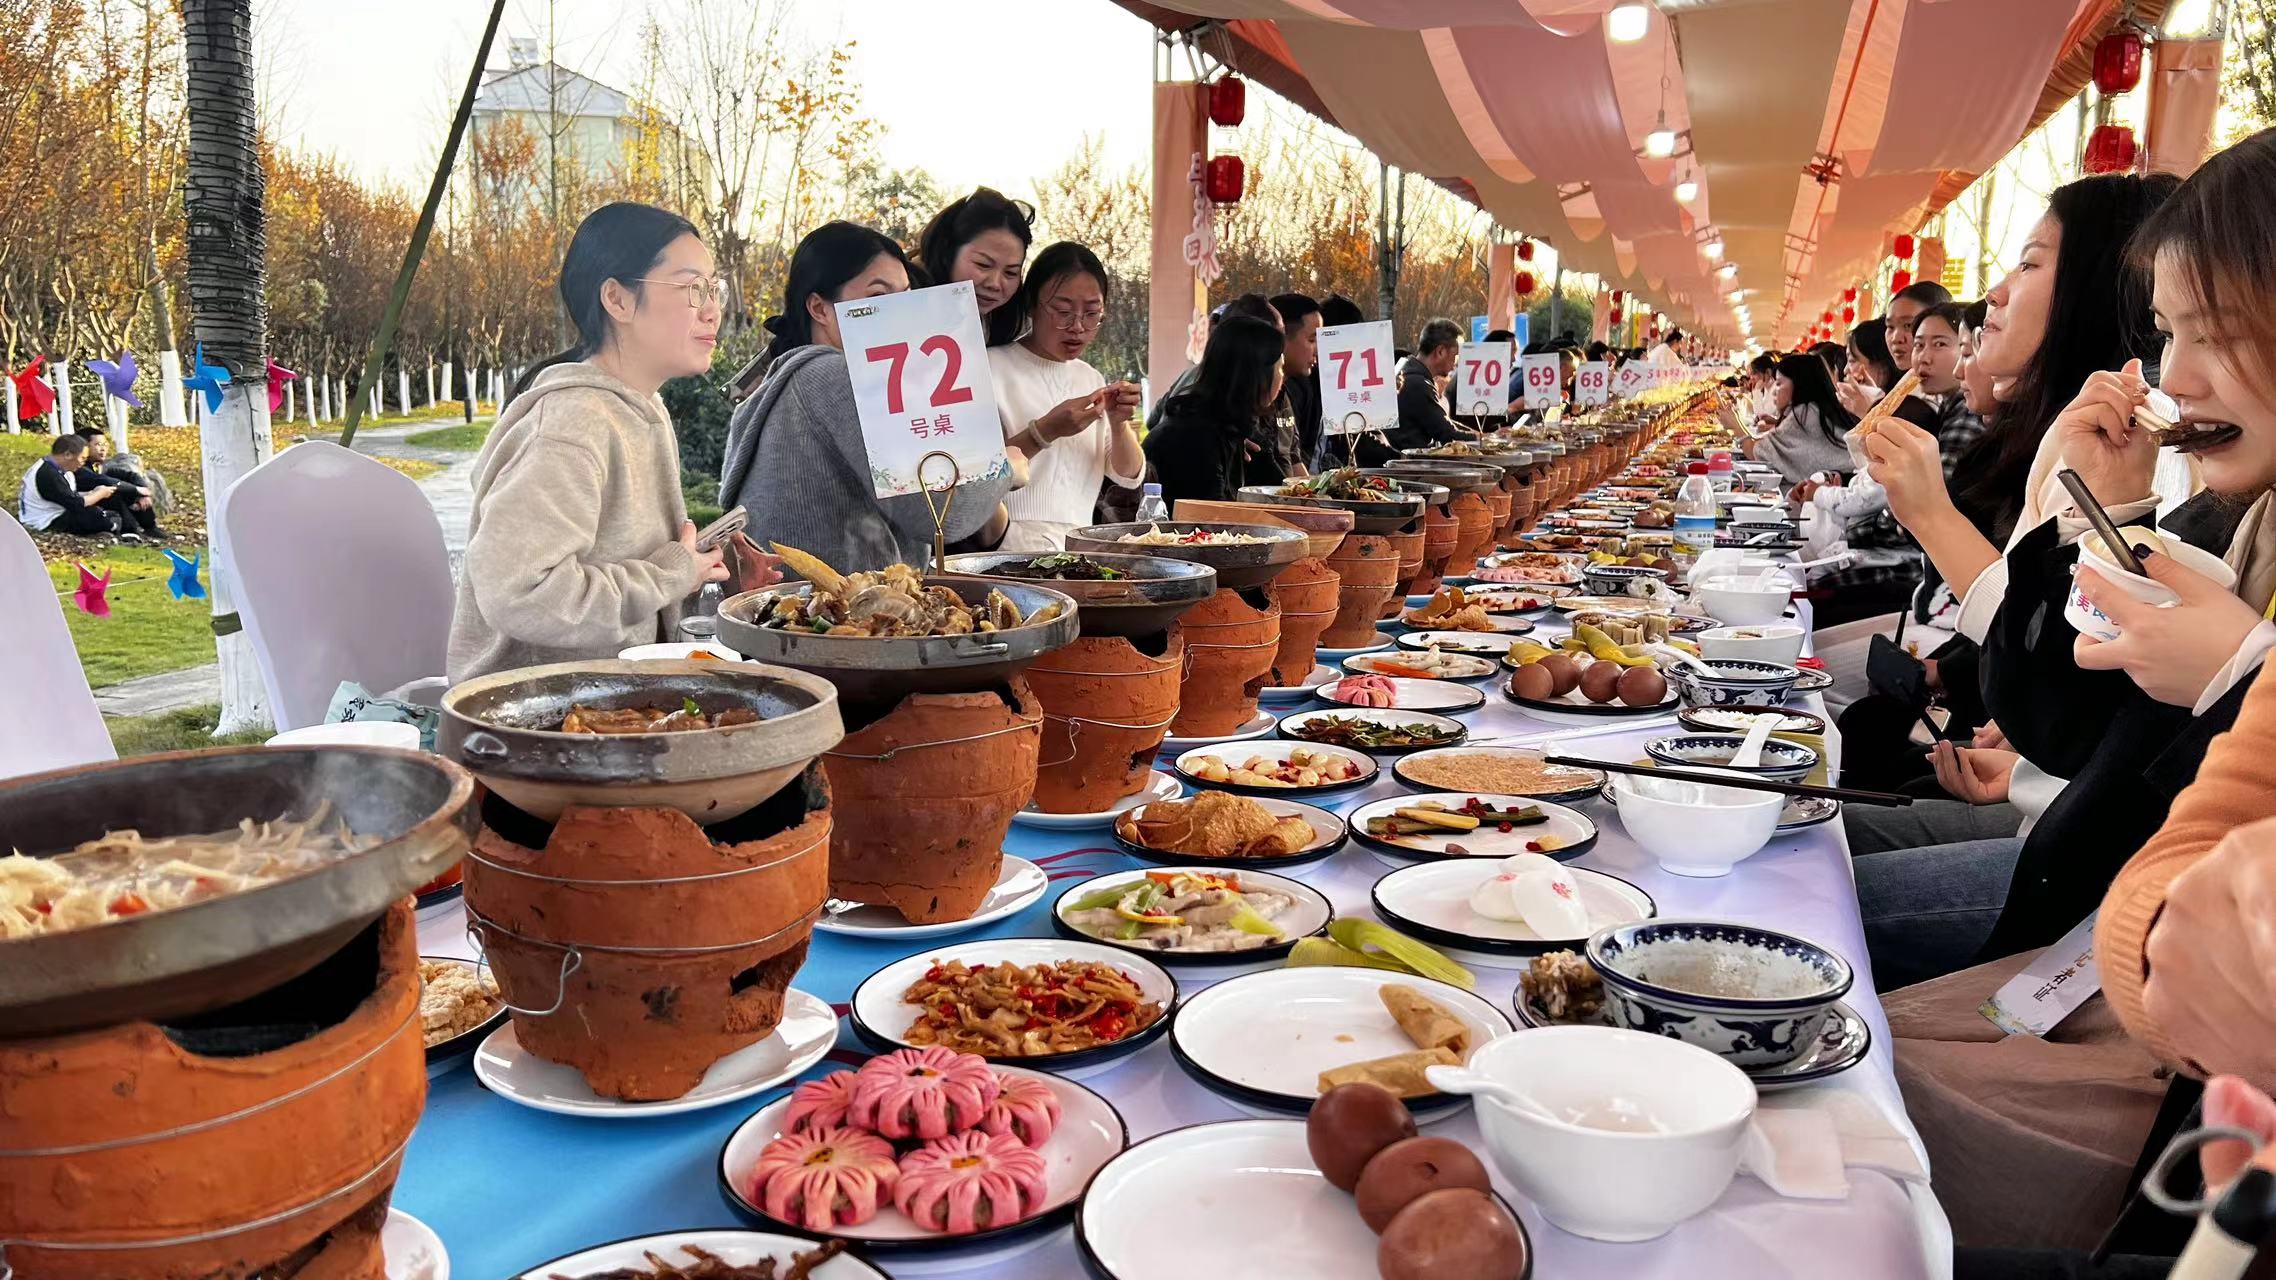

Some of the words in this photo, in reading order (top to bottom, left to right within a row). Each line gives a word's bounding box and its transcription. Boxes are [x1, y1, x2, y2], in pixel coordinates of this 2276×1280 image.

[865, 334, 974, 415] 72
[1329, 347, 1384, 390] 71
[1465, 359, 1502, 386] 70
[1528, 366, 1555, 387] 69
[1580, 371, 1603, 388] 68
[1621, 368, 1641, 386] 67
[1347, 391, 1372, 405] 号桌
[910, 413, 955, 440] 号桌
